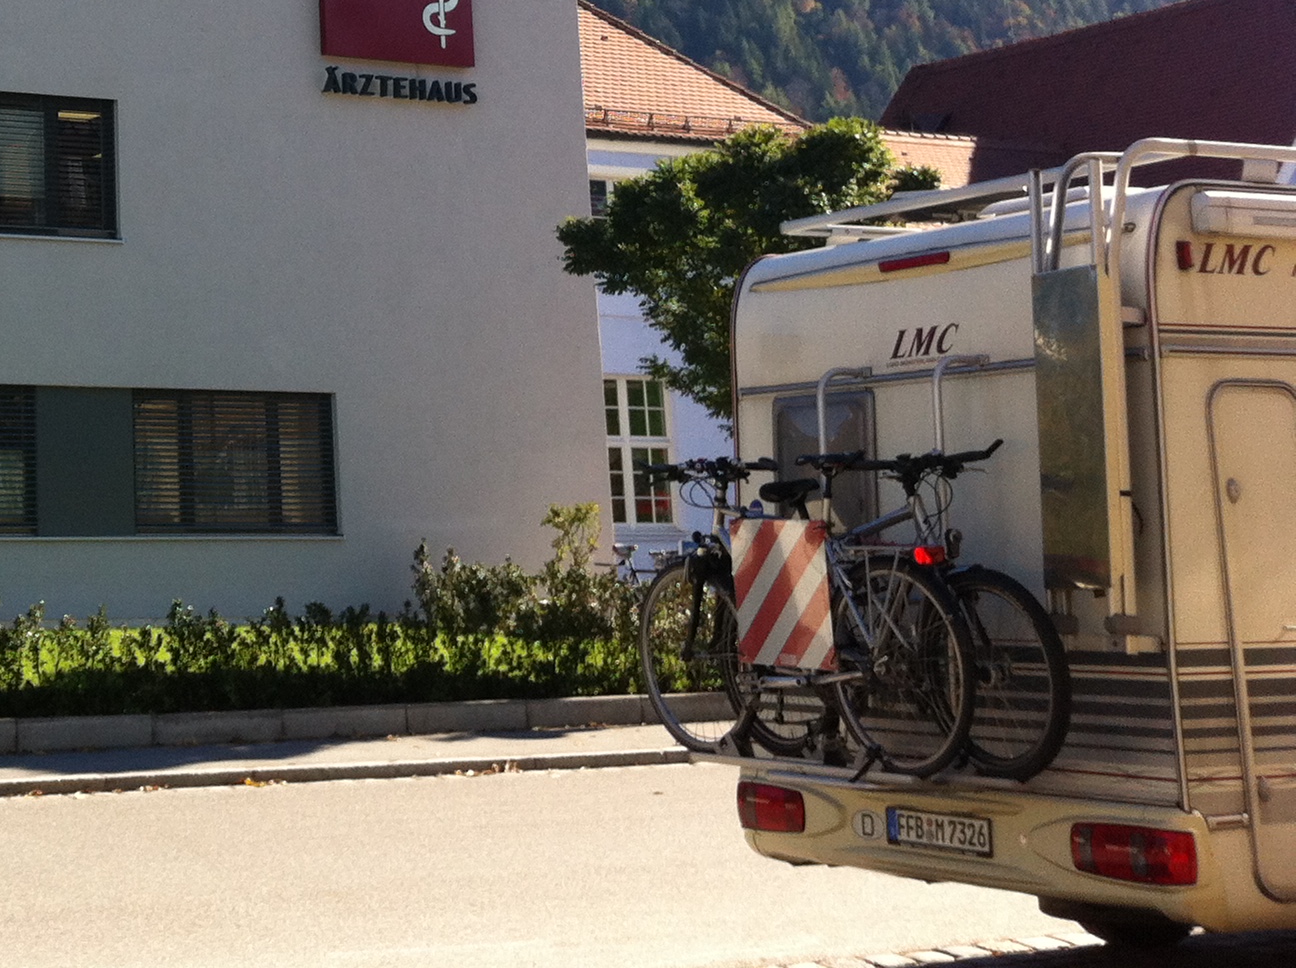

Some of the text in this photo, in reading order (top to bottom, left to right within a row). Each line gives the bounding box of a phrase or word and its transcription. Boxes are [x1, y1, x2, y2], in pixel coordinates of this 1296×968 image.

[321, 65, 478, 104] ÄRZTEHAUS
[1198, 242, 1276, 276] LMC
[890, 322, 960, 360] LMC
[861, 812, 875, 837] D
[897, 813, 925, 840] FFB
[948, 820, 987, 848] 7326
